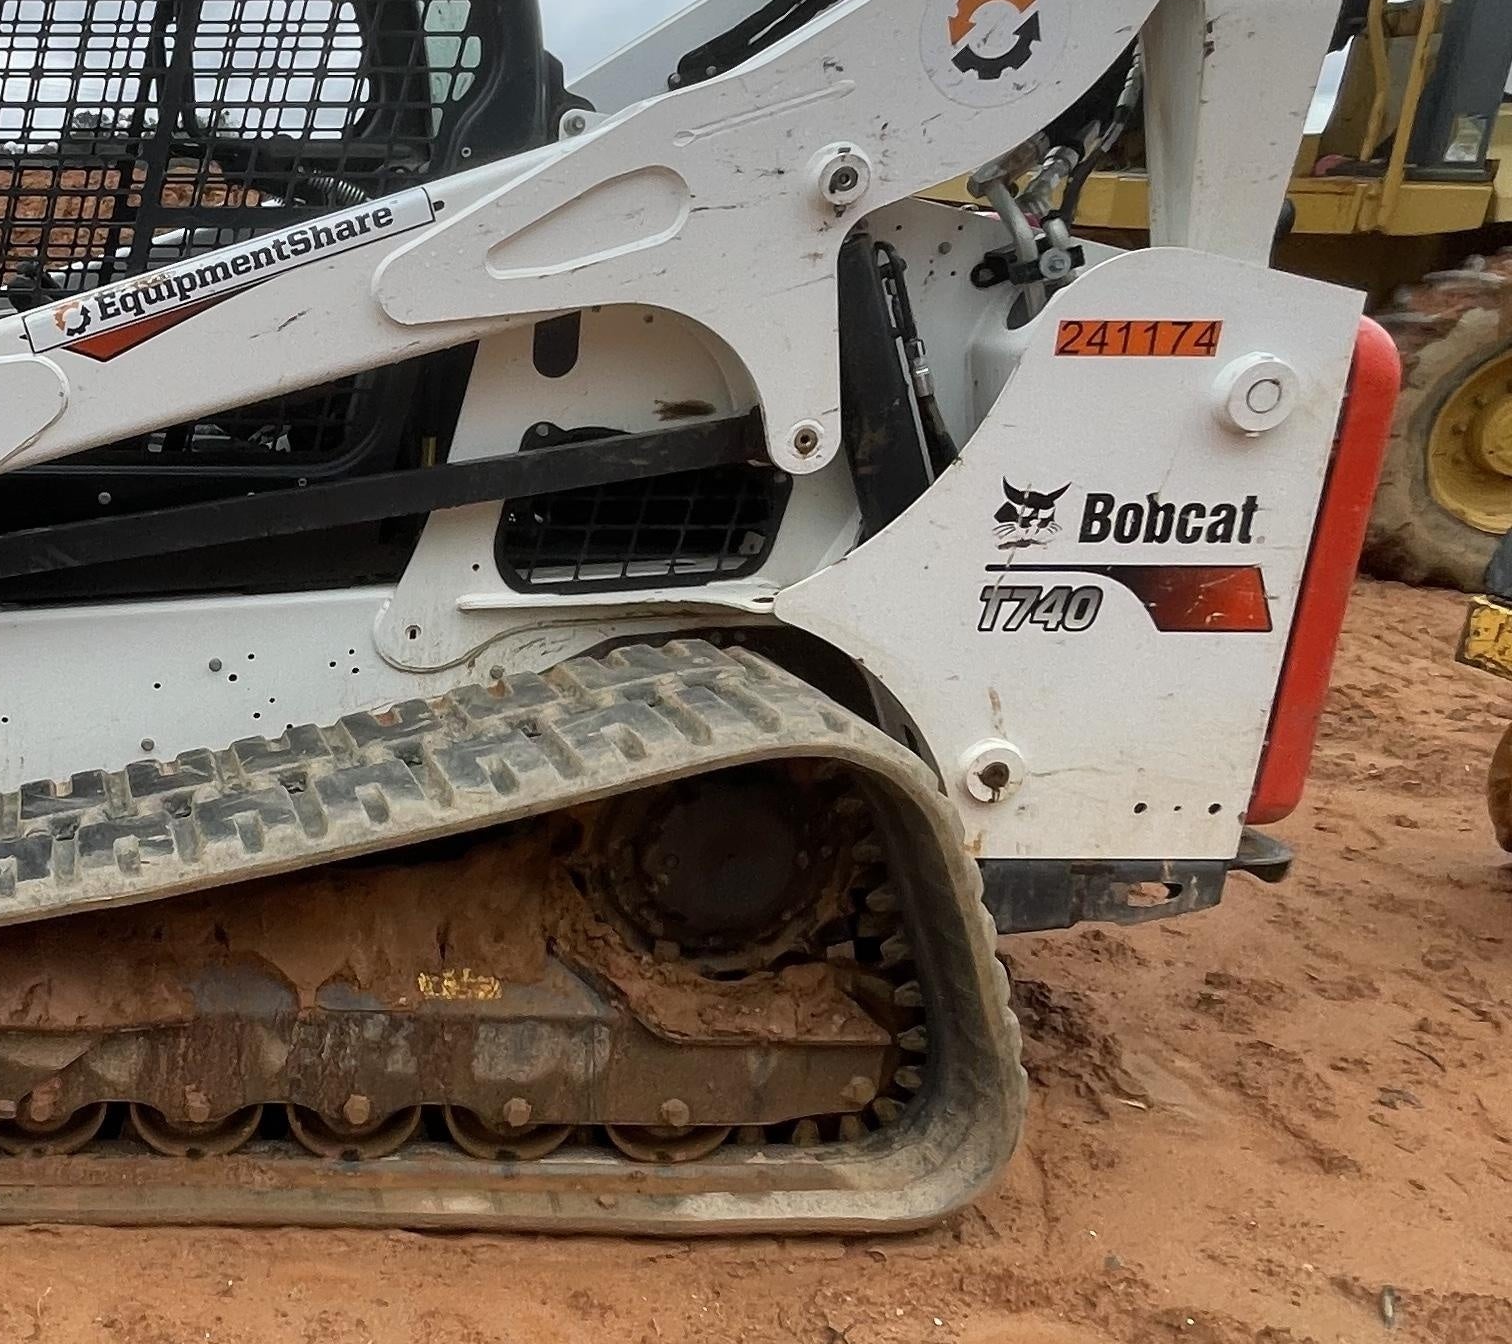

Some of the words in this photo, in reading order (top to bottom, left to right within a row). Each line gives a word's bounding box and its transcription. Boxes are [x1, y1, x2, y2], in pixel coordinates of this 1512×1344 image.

[97, 207, 394, 321] EquipmentShare
[1057, 321, 1218, 355] 241174
[1078, 492, 1259, 544] Bobcat
[977, 586, 1104, 632] T740
